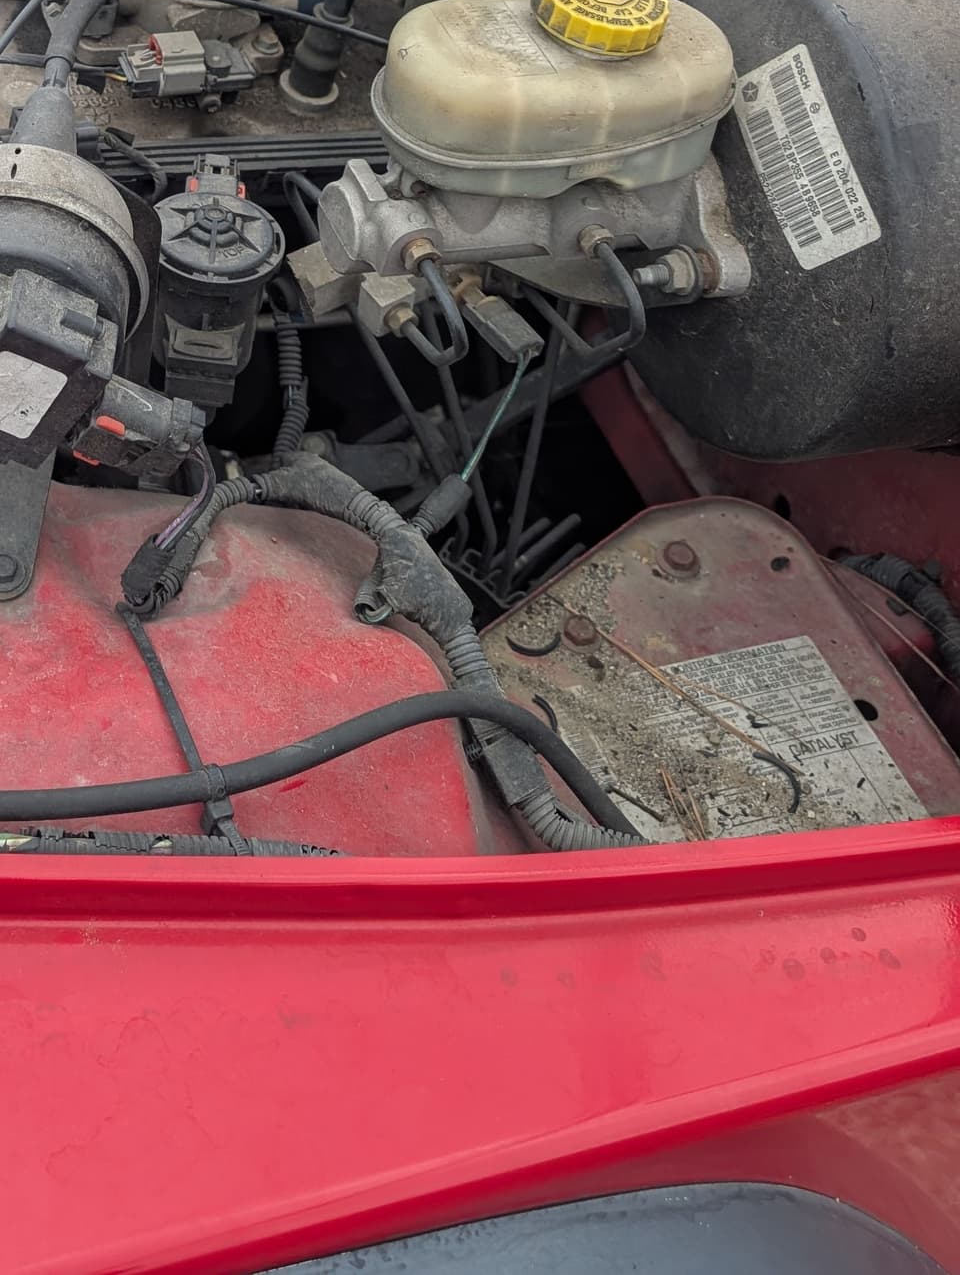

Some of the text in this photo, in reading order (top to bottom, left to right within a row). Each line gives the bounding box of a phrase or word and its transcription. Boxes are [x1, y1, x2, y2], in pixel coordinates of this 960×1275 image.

[792, 53, 811, 91] BOSCH
[829, 150, 868, 224] E 0 204 022 291
[670, 656, 717, 674] ONTROL
[788, 730, 860, 758] CATALYST
